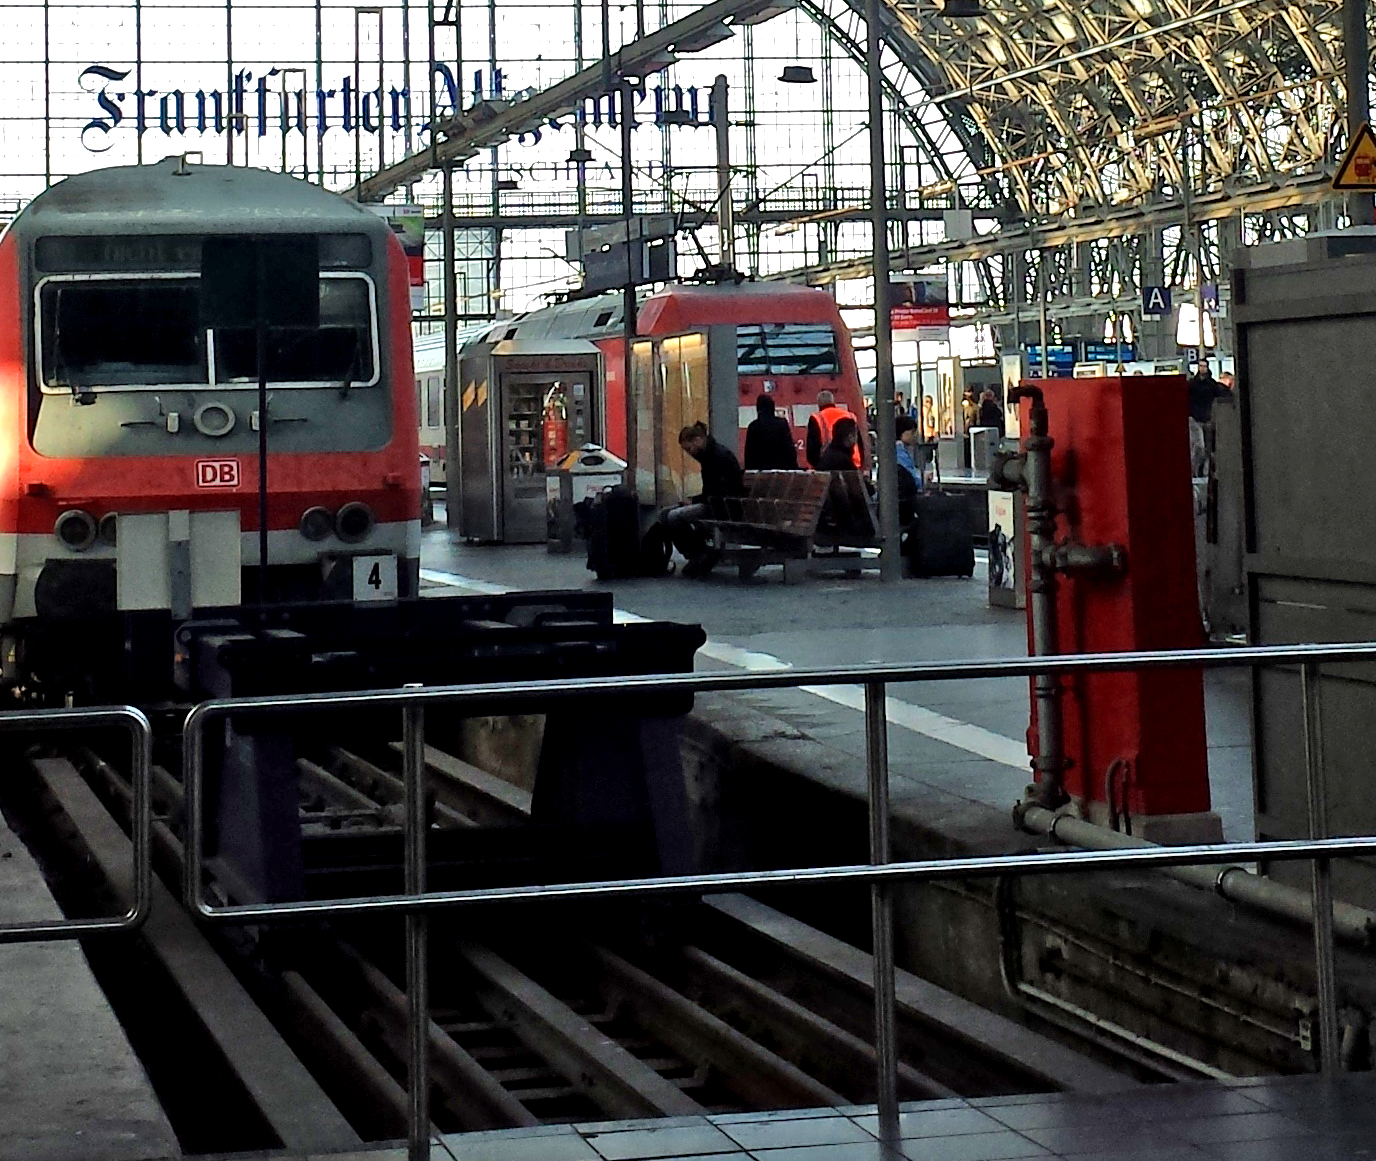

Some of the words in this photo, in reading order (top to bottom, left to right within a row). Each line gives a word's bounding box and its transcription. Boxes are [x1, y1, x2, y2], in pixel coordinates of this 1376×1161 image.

[1148, 287, 1166, 310] A
[1187, 348, 1198, 362] B
[200, 463, 236, 484] DB
[367, 562, 382, 590] 4
